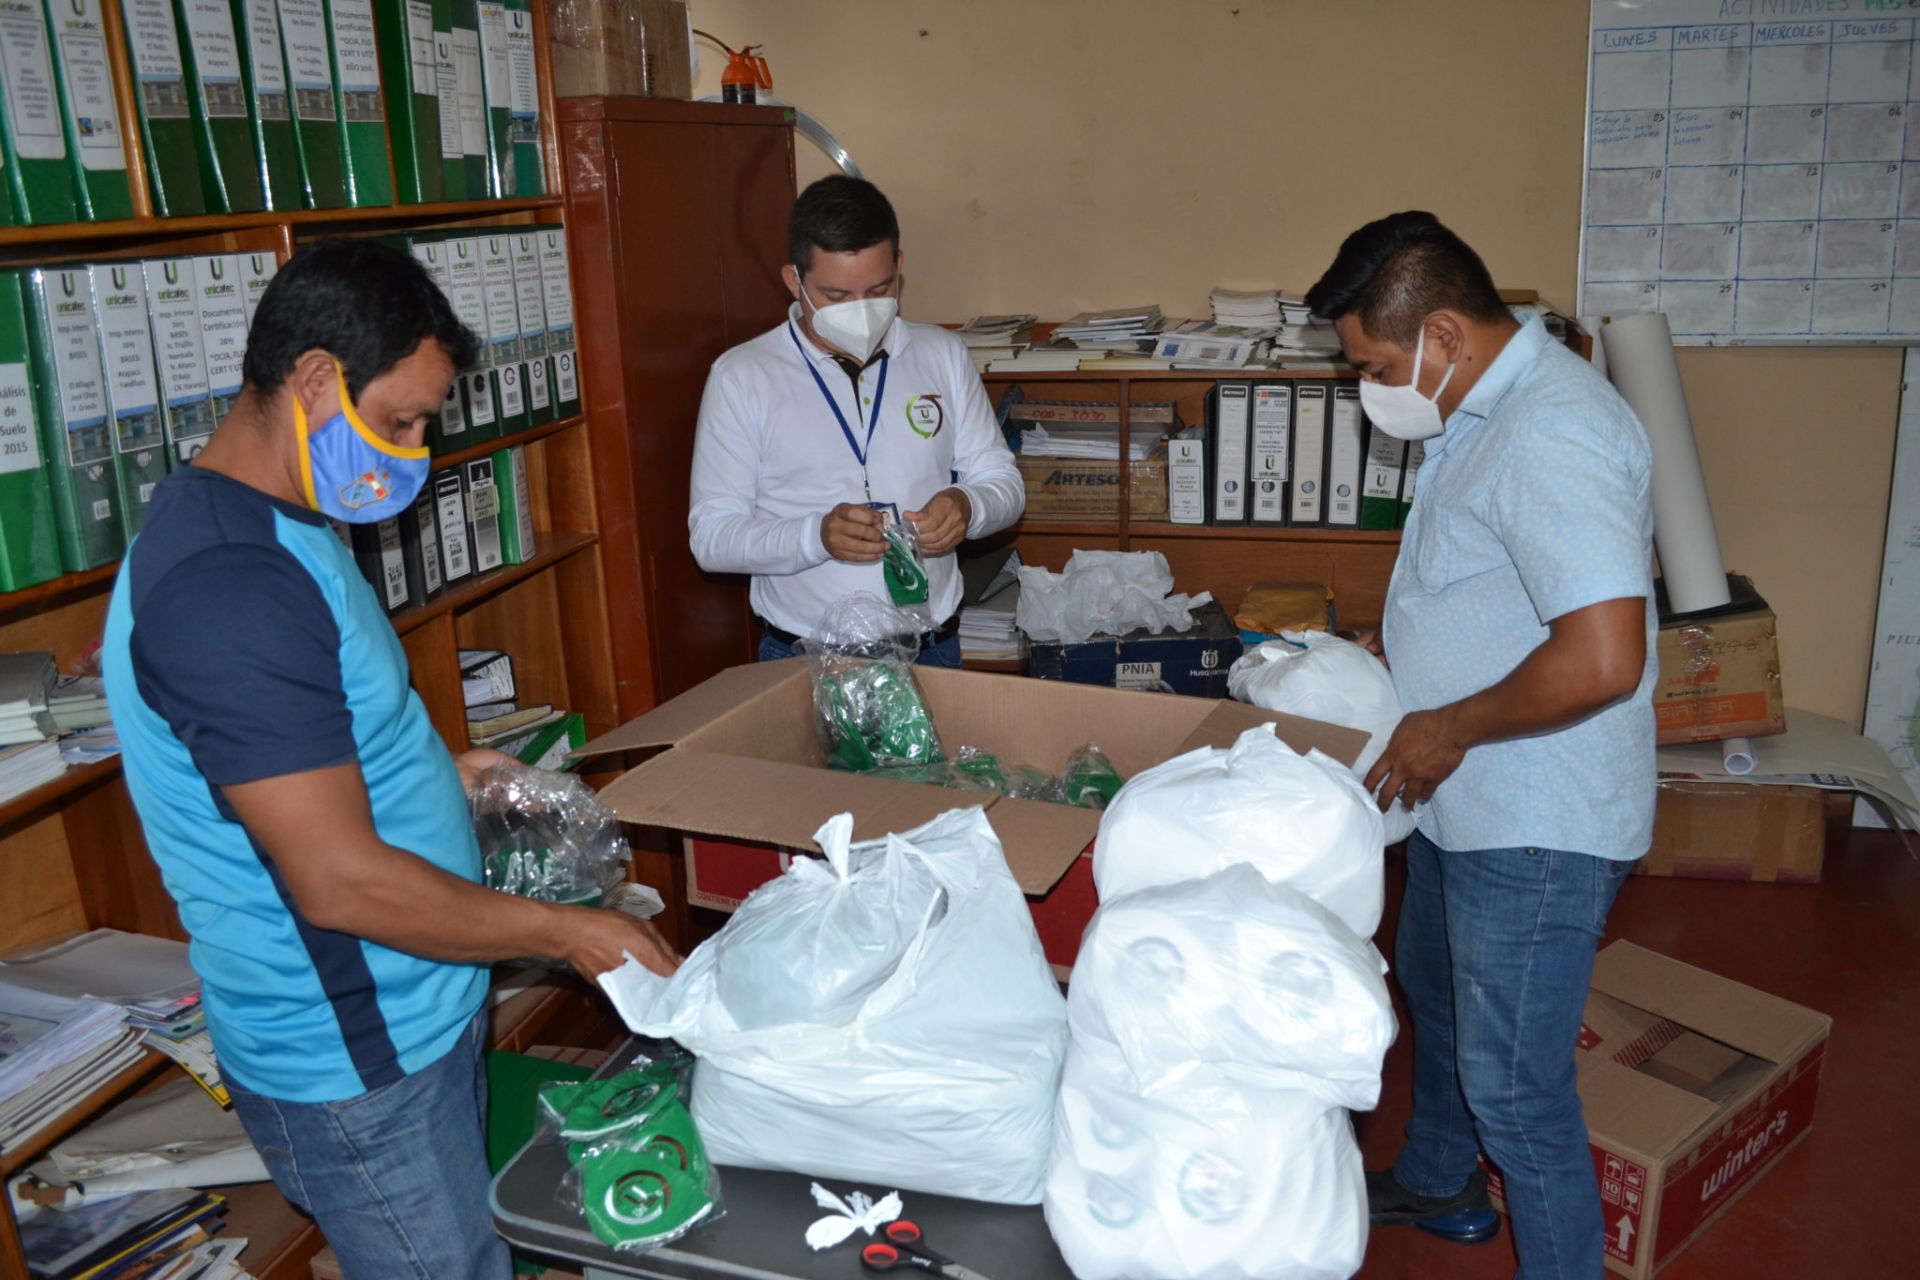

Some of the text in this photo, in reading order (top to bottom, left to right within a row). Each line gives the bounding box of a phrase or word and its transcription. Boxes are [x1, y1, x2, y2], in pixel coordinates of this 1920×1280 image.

[1679, 27, 1738, 44] MARTES
[1755, 24, 1825, 41] MIERCOLES
[1603, 31, 1657, 48] LUNES
[1729, 110, 1743, 121] 04
[1649, 169, 1661, 180] 10
[1728, 168, 1738, 177] 11
[1806, 166, 1818, 177] 12
[202, 307, 243, 318] Documentos
[4, 405, 17, 417] de
[4, 441, 28, 455] 2015
[1043, 469, 1121, 487] ARTESC
[1122, 664, 1155, 675] PNIA
[1604, 1181, 1619, 1195] 10
